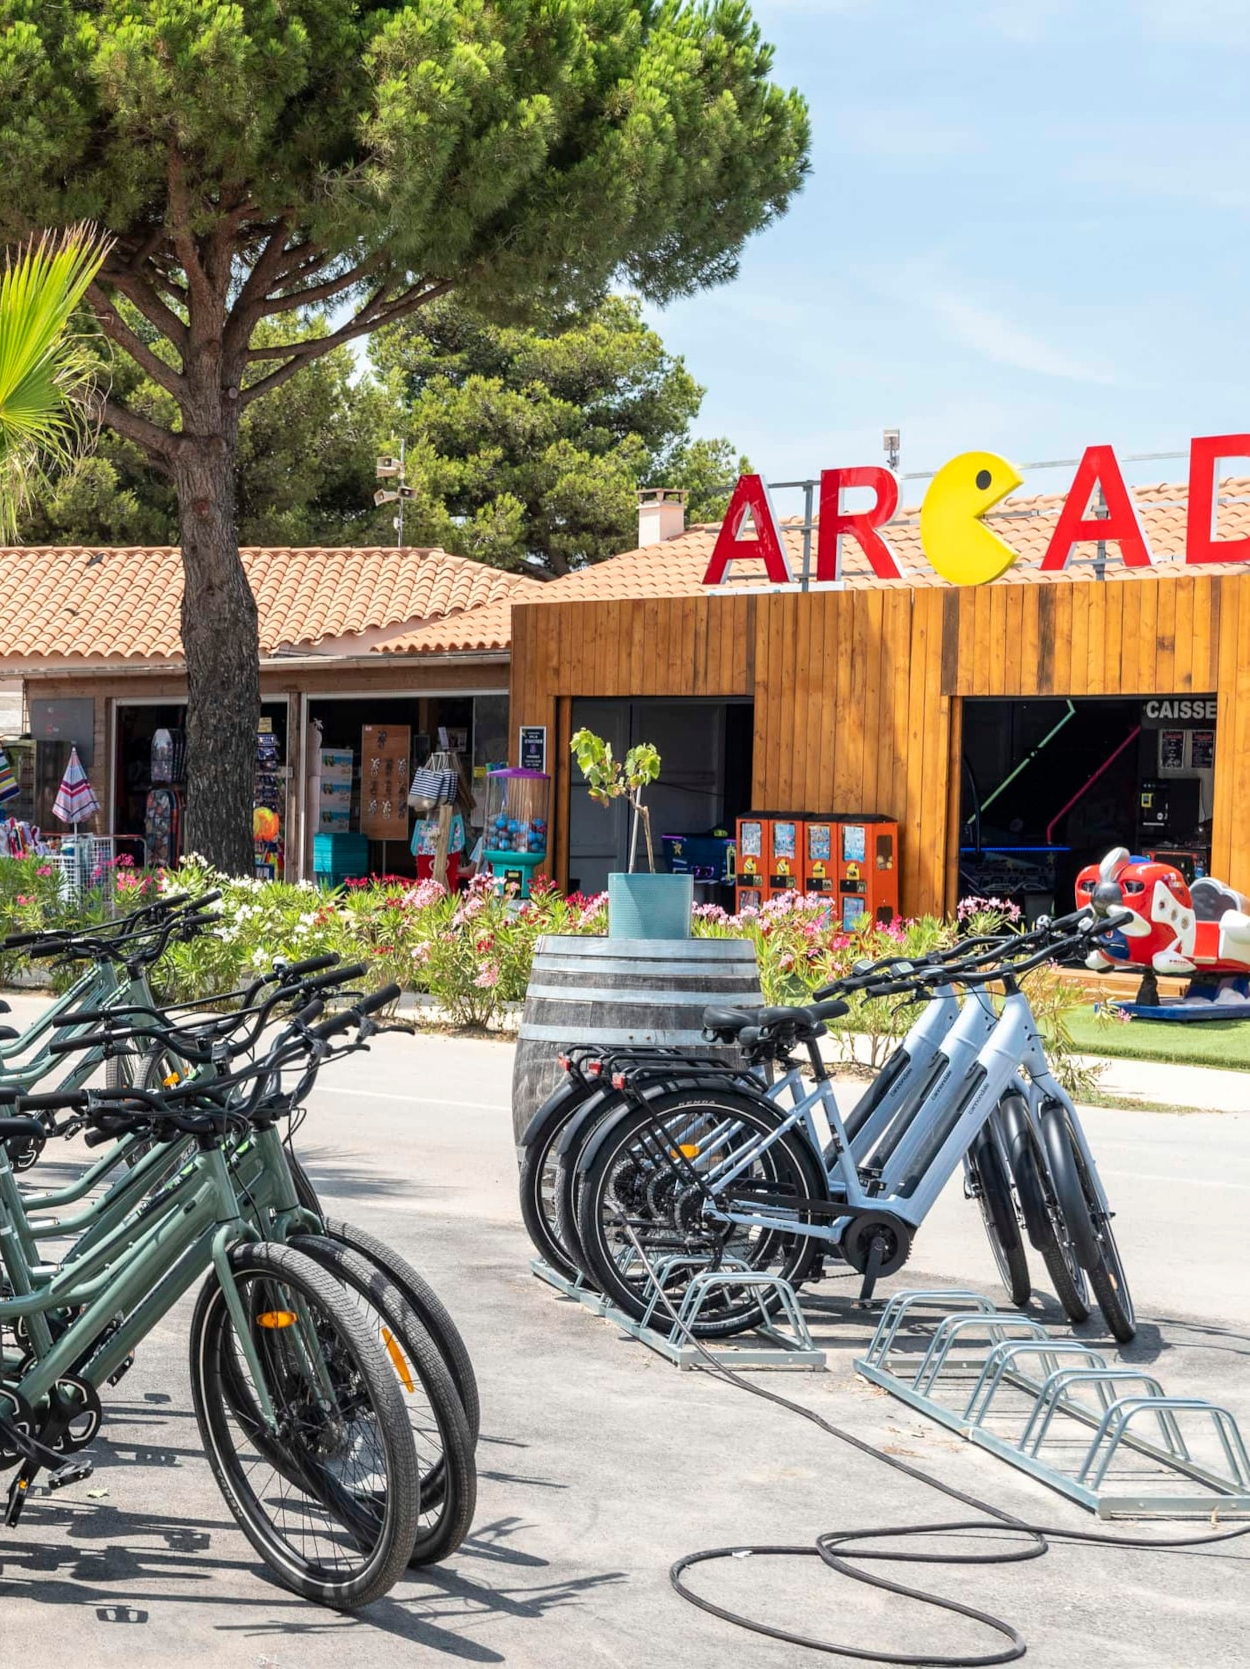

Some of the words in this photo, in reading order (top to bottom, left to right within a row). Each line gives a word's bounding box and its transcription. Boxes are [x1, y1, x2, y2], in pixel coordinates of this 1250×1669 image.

[1146, 700, 1217, 719] CAISSE
[890, 1067, 913, 1098] cannondale
[930, 1070, 953, 1101] cannondale
[968, 1082, 991, 1115] cannondale
